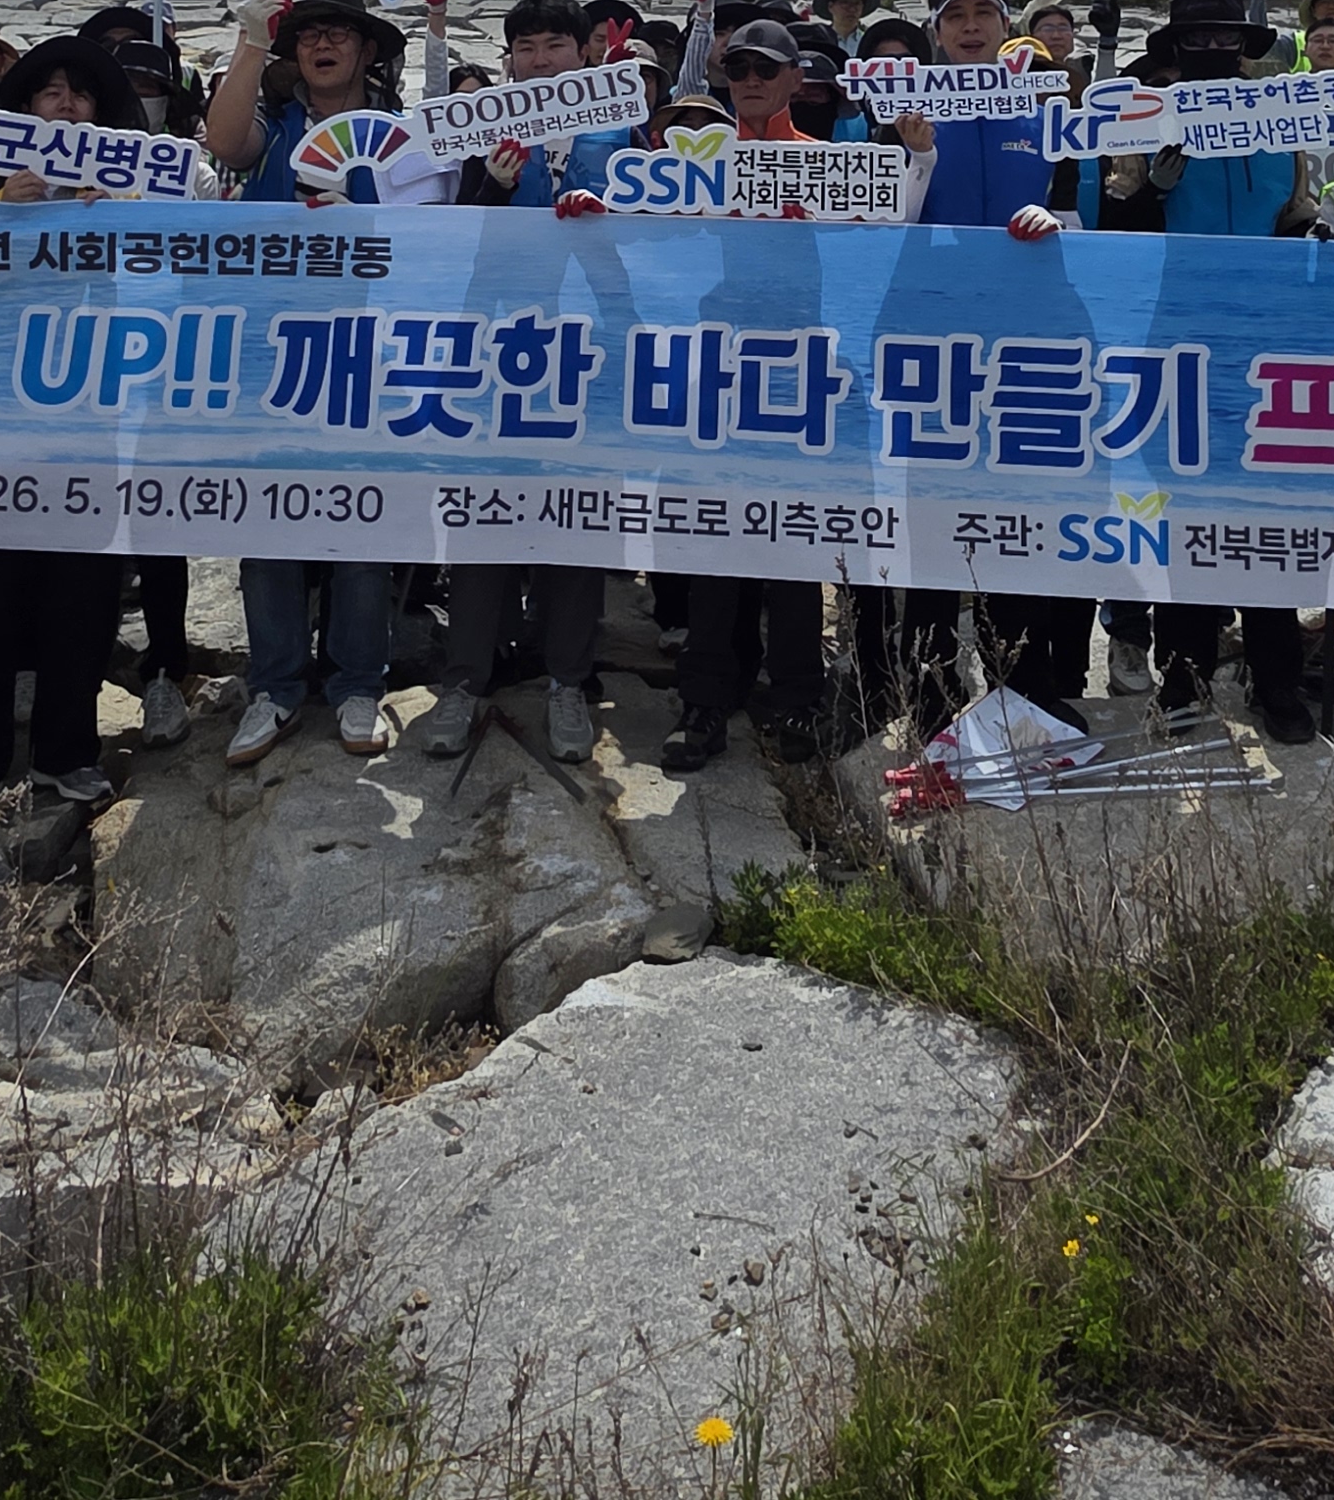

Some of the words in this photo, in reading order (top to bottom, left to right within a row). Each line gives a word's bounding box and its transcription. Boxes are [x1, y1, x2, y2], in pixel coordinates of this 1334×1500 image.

[421, 68, 637, 135] FOODPOLIS
[841, 61, 915, 95] KH
[431, 100, 641, 157] 한국식품산업클러스터진흥원
[876, 95, 1033, 118] 한국건강관리협회
[1181, 114, 1323, 151] 새만금사업단
[611, 156, 726, 206] SSN
[733, 149, 901, 181] 전북특별자치도
[731, 180, 900, 213] 사회복지협의회
[29, 230, 393, 280] 사회공헌연합활동
[20, 312, 238, 408] UP!!
[269, 314, 596, 439] 깨끗한
[631, 329, 843, 447] 바다
[880, 341, 1202, 468] 만들기
[64, 477, 102, 516] 5.
[261, 483, 384, 525] 10:30
[437, 486, 525, 528] 장소:
[538, 488, 731, 538] 새만금도로
[743, 500, 900, 550] 외측호안
[952, 511, 1045, 557] 주관:
[1057, 513, 1169, 567] SSN
